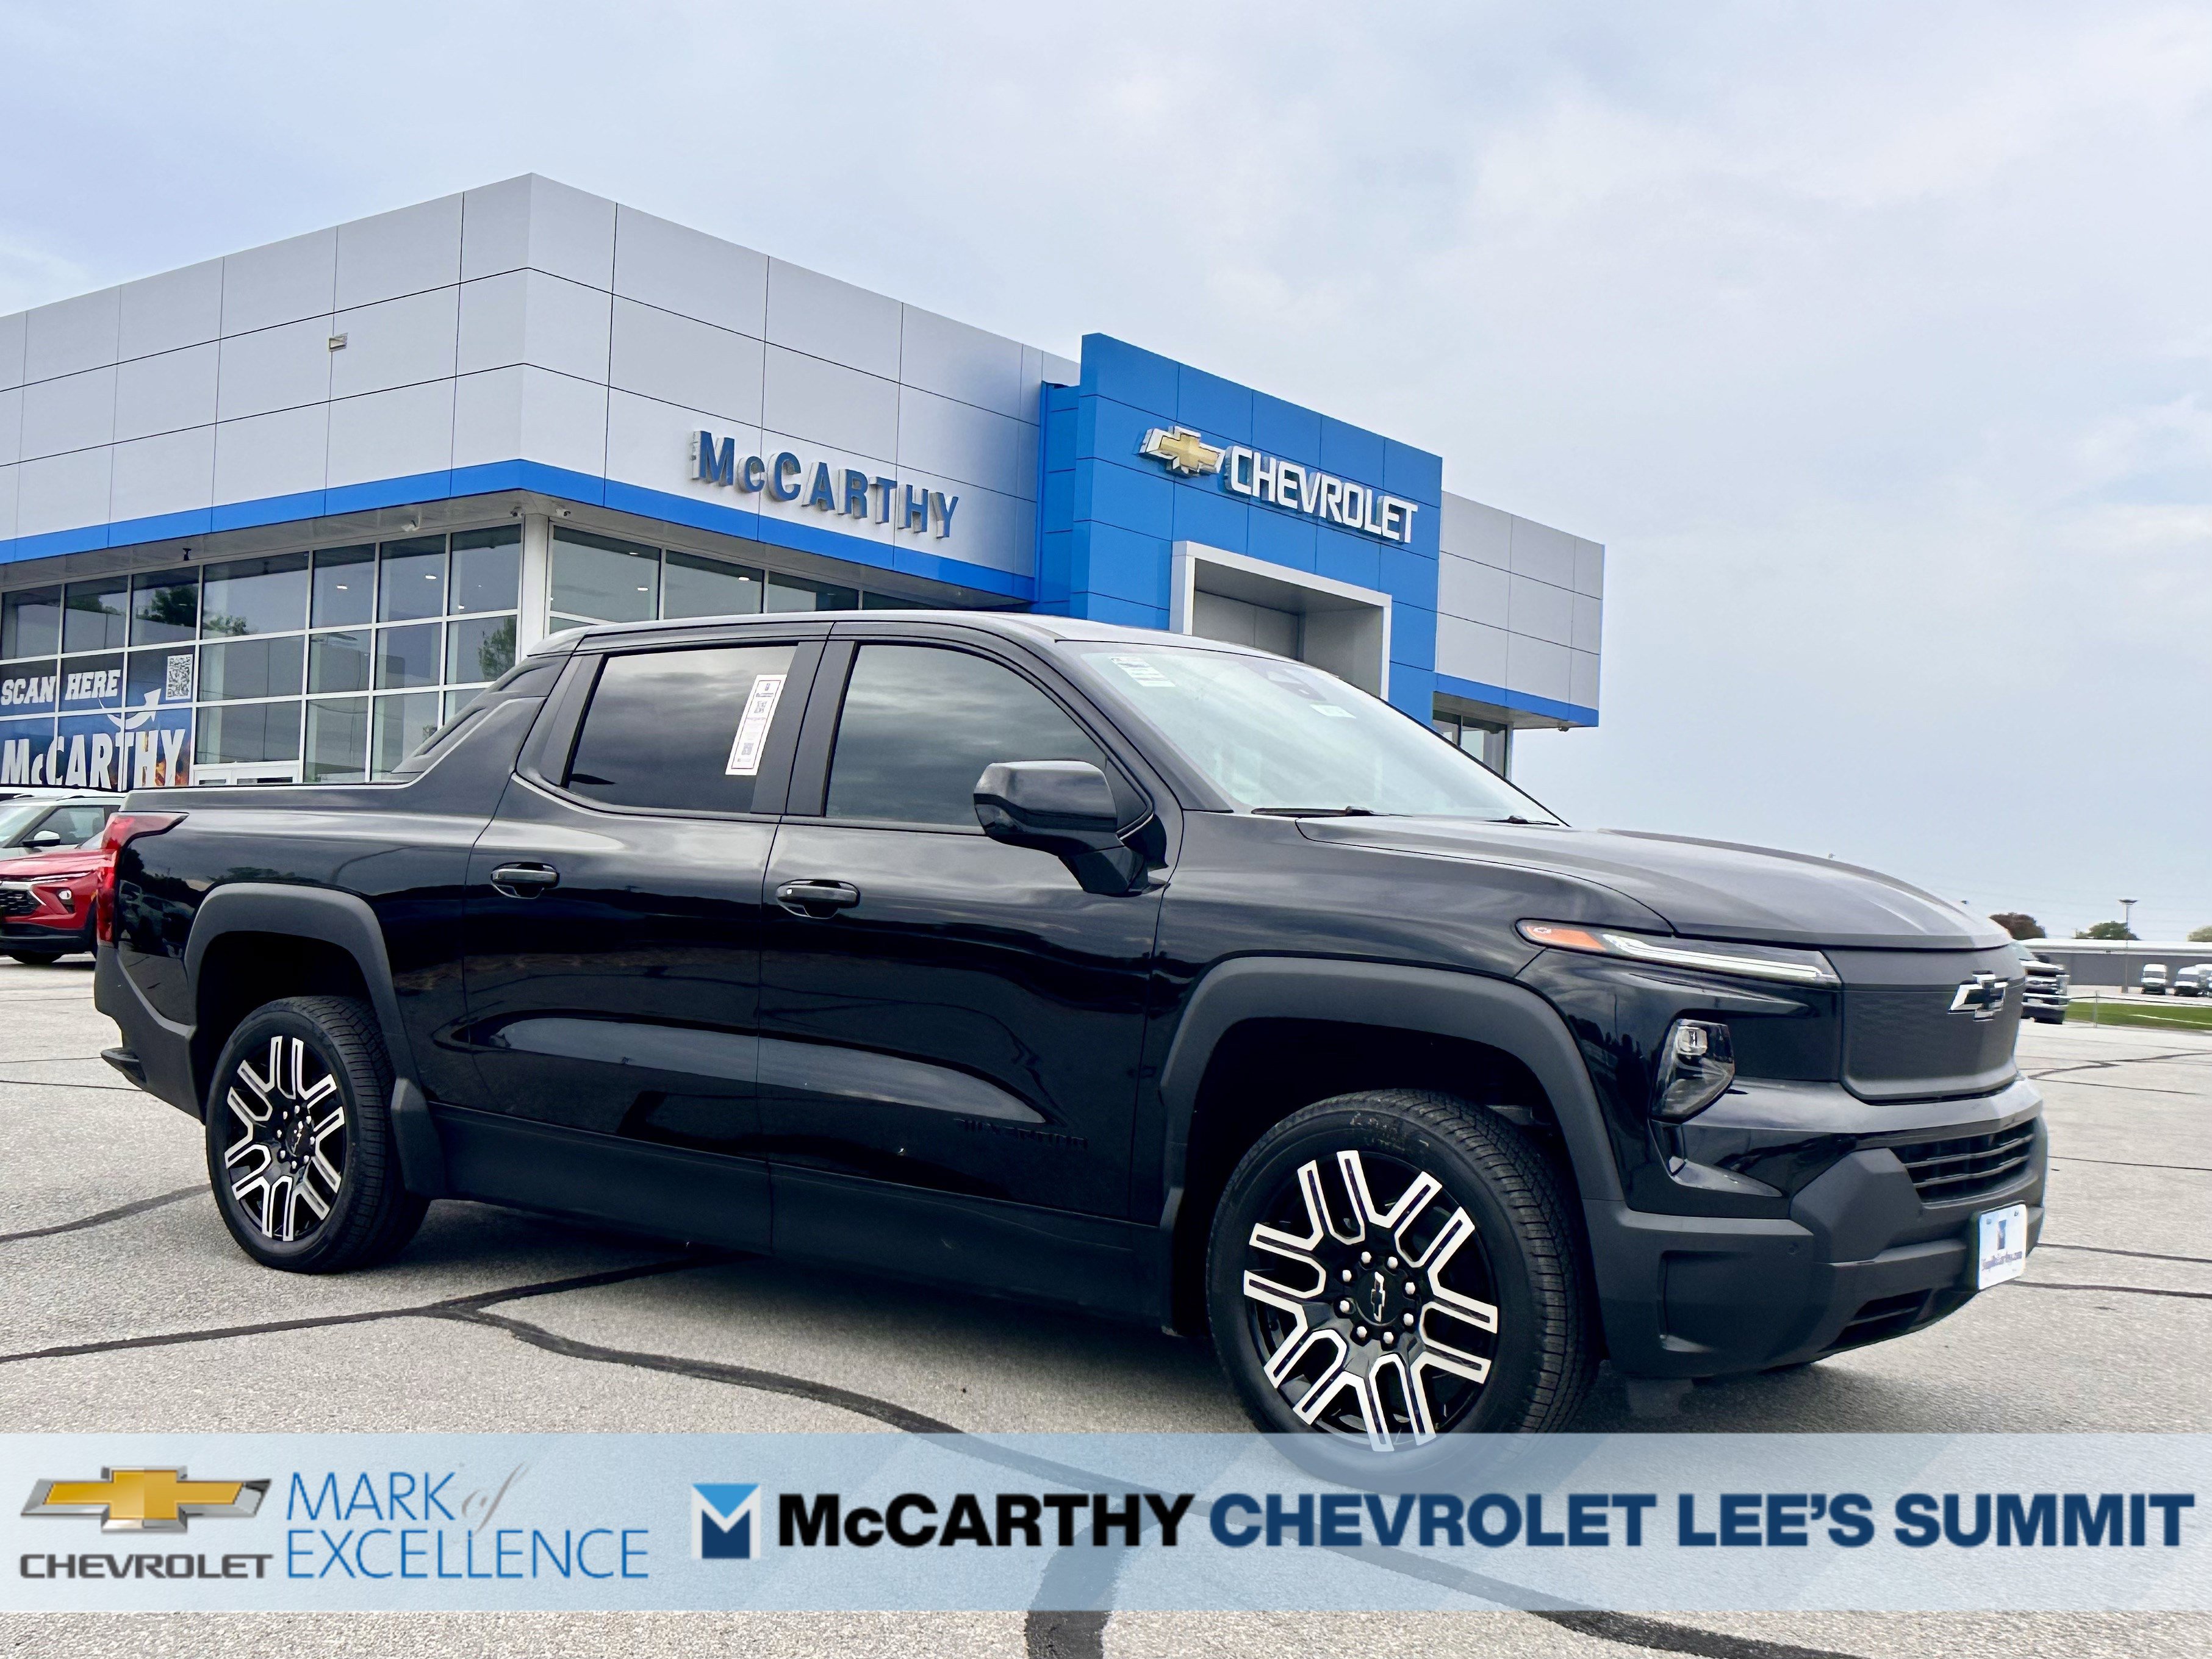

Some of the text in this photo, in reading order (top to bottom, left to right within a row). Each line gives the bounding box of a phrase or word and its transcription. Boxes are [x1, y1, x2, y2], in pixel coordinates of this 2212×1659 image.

[691, 430, 959, 540] McCARTHY
[1225, 445, 1418, 543] CHEVROLET
[1, 671, 121, 705] SCAN HERE
[2, 729, 185, 790] McCARTHY
